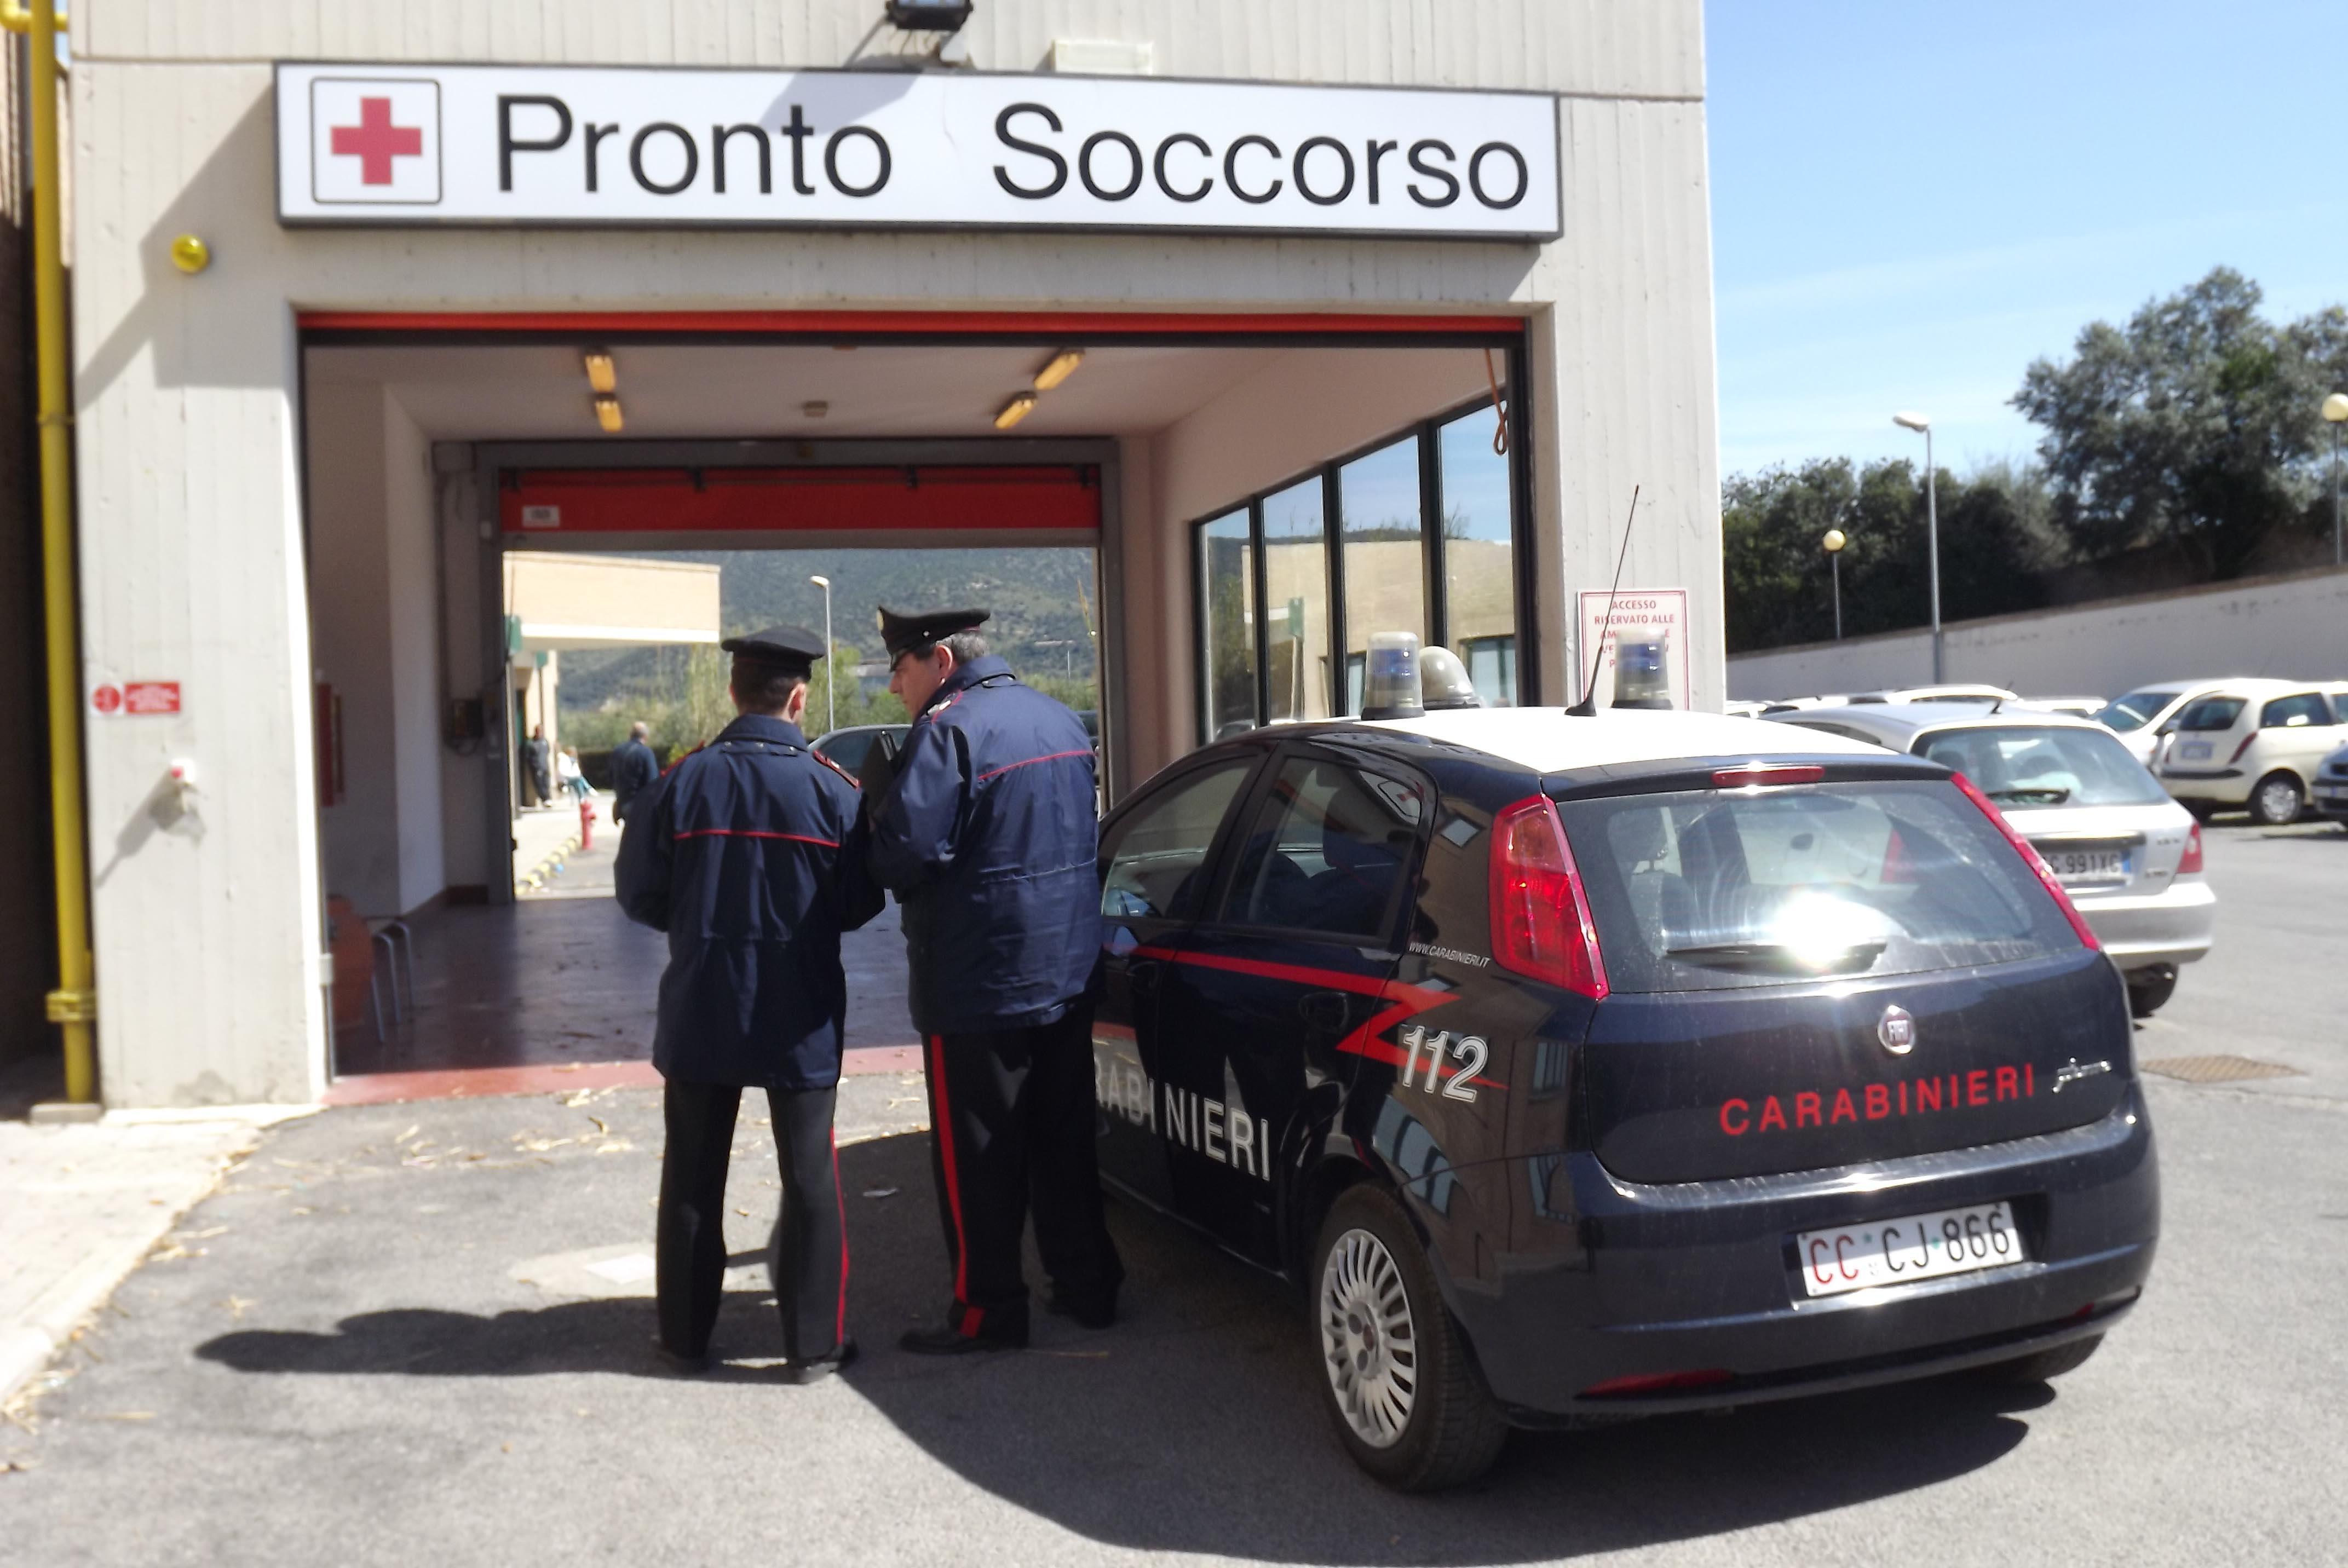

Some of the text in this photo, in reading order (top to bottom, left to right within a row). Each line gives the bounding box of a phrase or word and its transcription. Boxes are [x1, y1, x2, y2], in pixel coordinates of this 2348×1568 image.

[497, 94, 1528, 210] Pronto Soccorso
[1612, 600, 1656, 609] ACCESSO
[1651, 614, 1674, 623] ALLE
[1402, 1025, 1488, 1103] 112
[1719, 1063, 2034, 1137] CARABINIERI
[1809, 1209, 2010, 1284] CC CJ 866
